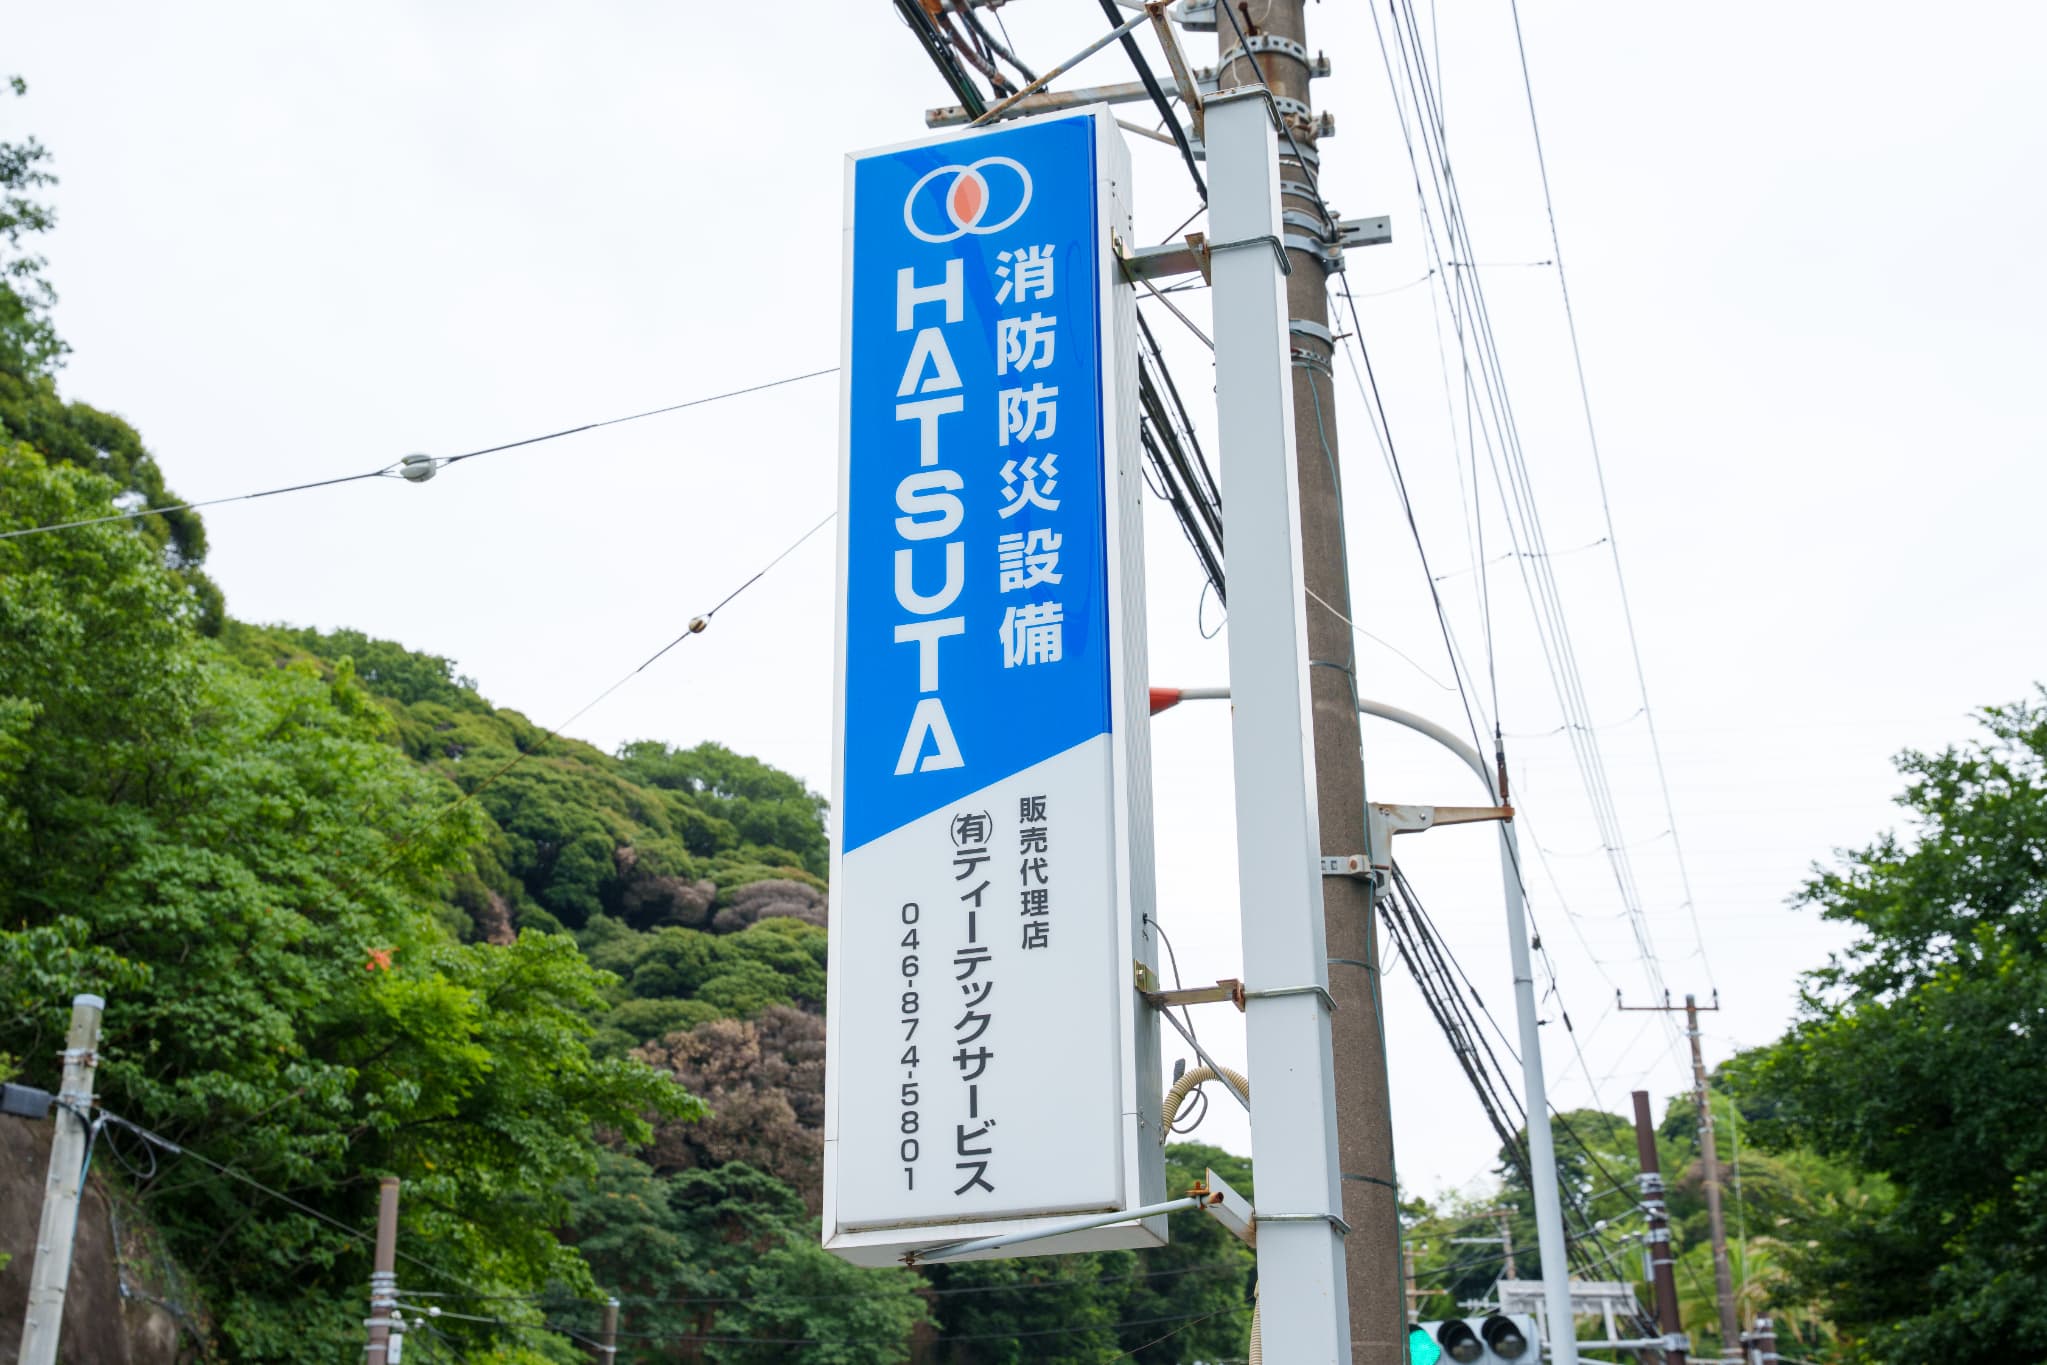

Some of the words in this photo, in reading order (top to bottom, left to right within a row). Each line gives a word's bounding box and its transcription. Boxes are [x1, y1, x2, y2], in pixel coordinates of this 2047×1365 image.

[894, 258, 965, 776] HATSUTA
[994, 243, 1064, 669] 消防防災設備
[900, 902, 920, 1191] 046-874-5801
[1019, 795, 1050, 950] 販売代理店
